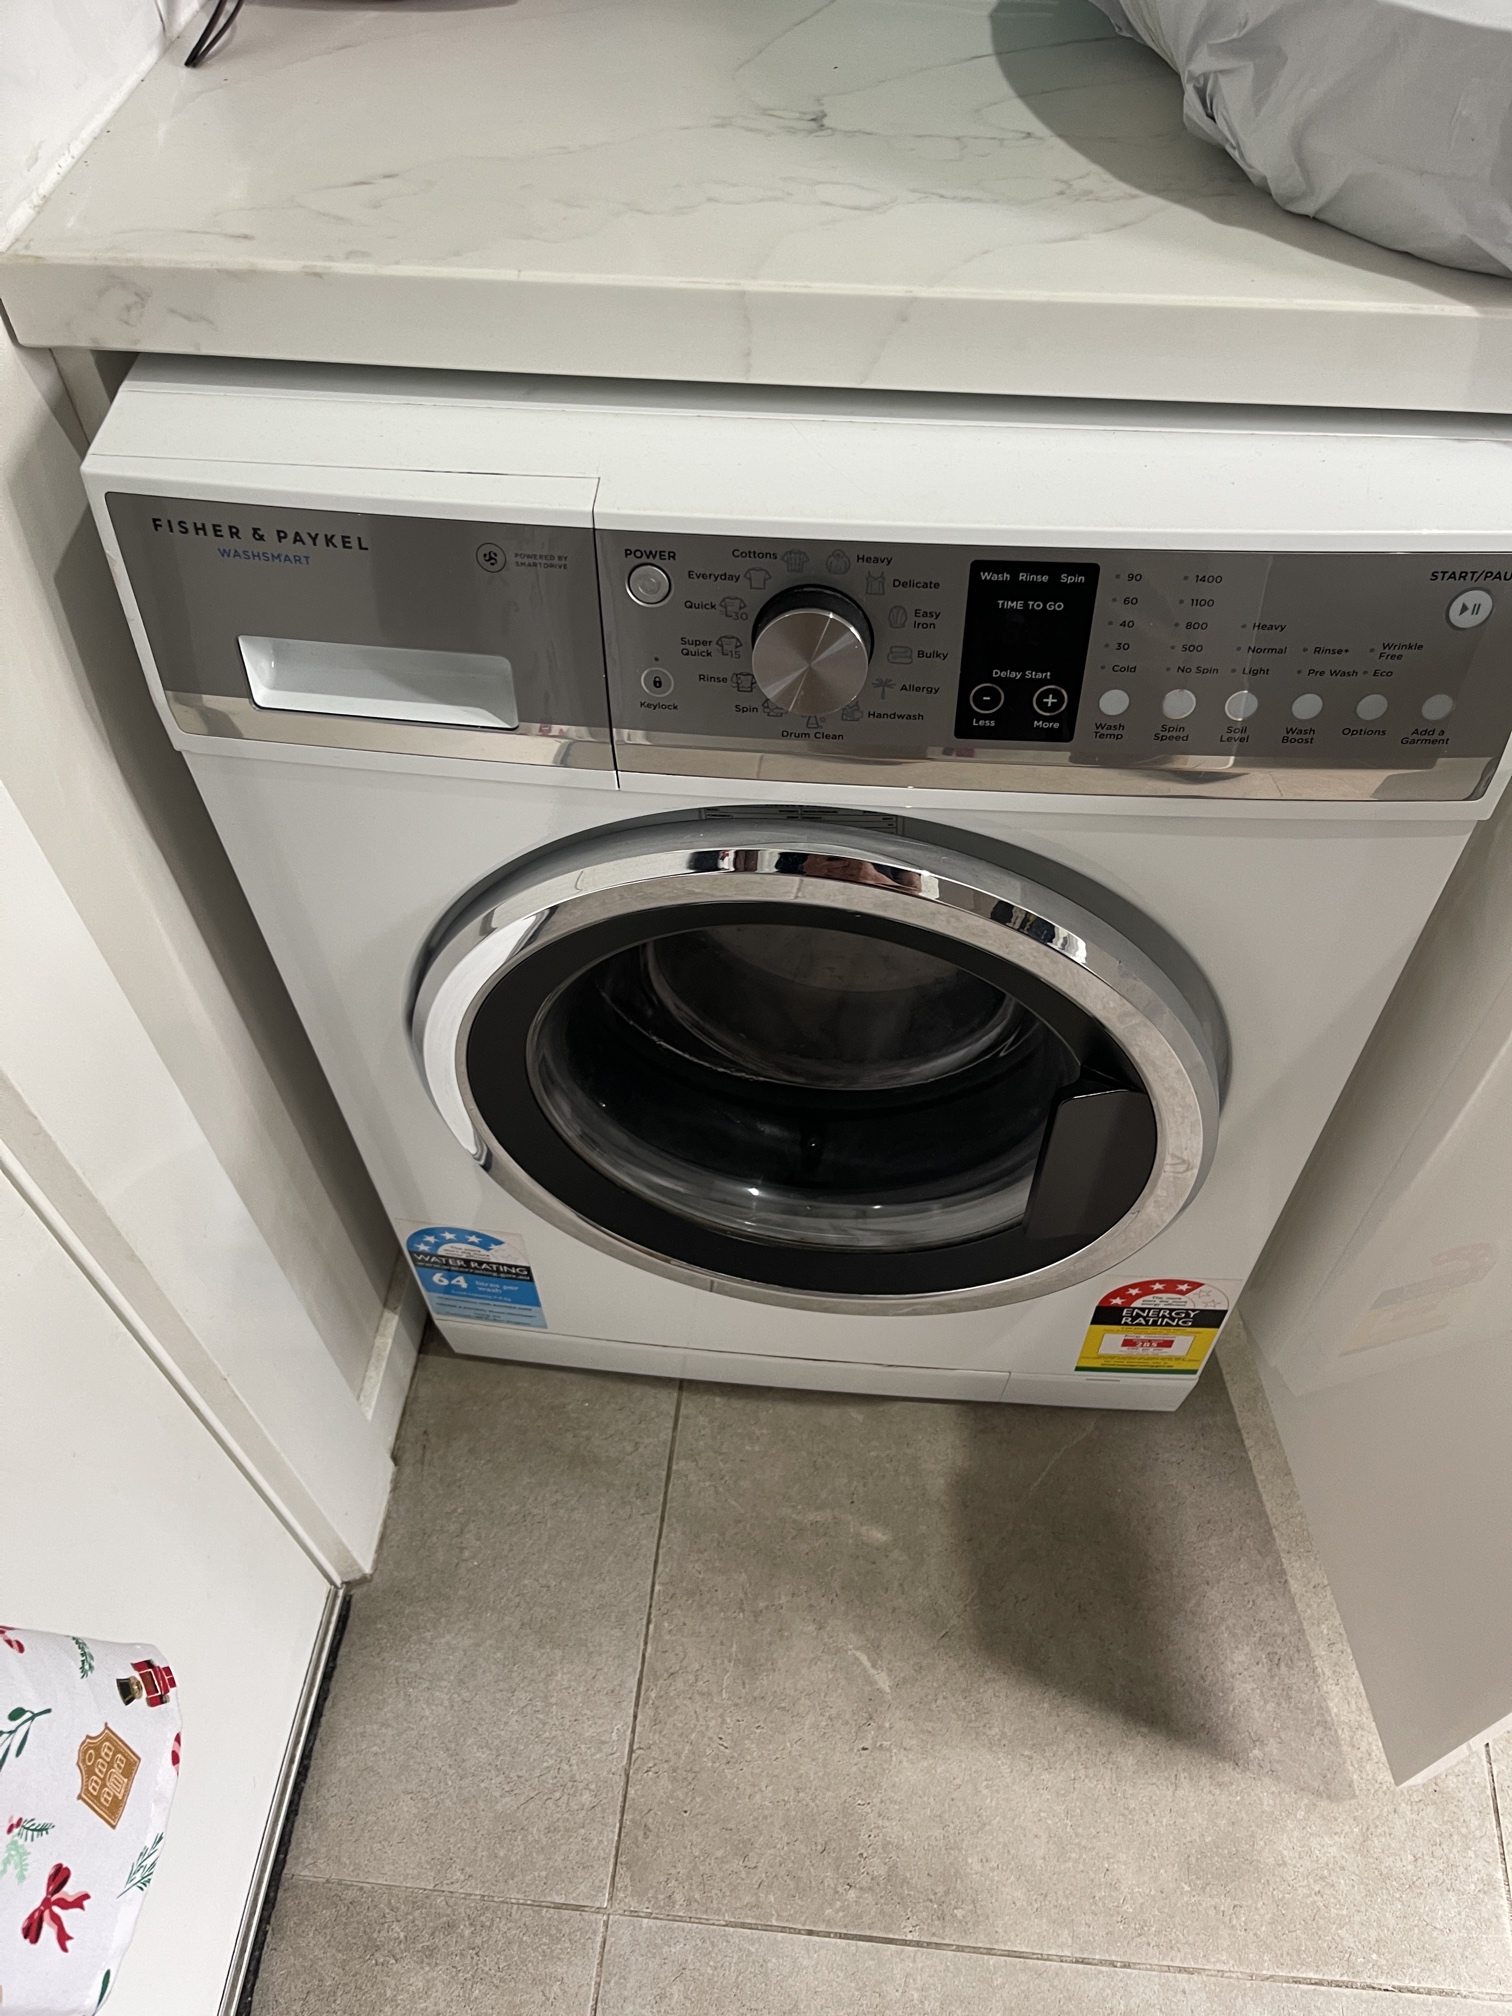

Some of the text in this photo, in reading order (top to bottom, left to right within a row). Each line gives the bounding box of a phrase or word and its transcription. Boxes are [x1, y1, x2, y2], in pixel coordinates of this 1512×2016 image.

[151, 517, 370, 551] FISHER & PAYKEL
[217, 547, 311, 566] WASHSMART
[514, 552, 556, 561] POWERED
[624, 548, 677, 561] POWER
[731, 548, 778, 560] Cottons
[856, 554, 893, 566] Heavy
[514, 561, 568, 570] SMARTDRIVE
[687, 570, 741, 584] Everyday
[980, 571, 1011, 581] Wash
[1018, 572, 1049, 582] Rinse
[1060, 573, 1086, 584] Spin
[1127, 573, 1143, 582] 90
[1194, 574, 1223, 584] 1400
[892, 579, 941, 590] Delicate
[684, 600, 717, 611] Quick
[997, 600, 1064, 611] TIME TO GO
[1123, 597, 1139, 606] 60
[1190, 598, 1215, 607] 1100
[732, 612, 748, 621] 30
[914, 609, 942, 620] Easy
[913, 621, 936, 629] Iron
[1119, 620, 1135, 629] 40
[1185, 621, 1208, 630] 800
[1252, 622, 1287, 633] Heavy
[680, 637, 713, 648] Super
[1115, 642, 1130, 651] 30
[1381, 642, 1424, 651] Wrinkle
[680, 648, 713, 658] Quick
[1180, 644, 1204, 653] 500
[1246, 646, 1288, 655] Normal
[1313, 646, 1350, 655] Rinse+
[917, 650, 949, 661] Bulky
[1378, 652, 1404, 661] Free
[1111, 664, 1137, 673] Cold
[1176, 665, 1219, 675] No Spin
[1242, 666, 1270, 676] Light
[1307, 669, 1359, 677] Pre Wash
[1372, 669, 1393, 677] Eco
[698, 674, 728, 684] Rinse
[992, 669, 1051, 680] Delay Start
[899, 684, 941, 695] Allergy
[639, 701, 679, 711] Keylock
[734, 704, 759, 714] Spin
[867, 711, 924, 721] Handwash
[972, 718, 996, 727] Less
[1033, 720, 1060, 729] More
[1094, 722, 1125, 732] Wash
[1160, 724, 1186, 734] Spin
[1225, 726, 1248, 735] Soil
[1285, 727, 1316, 736] Wash
[1341, 727, 1387, 737] Options
[1410, 728, 1445, 737] Add a
[781, 730, 844, 740] Drum Clean
[1093, 731, 1123, 741] Temp
[1153, 733, 1189, 742] Speed
[1219, 735, 1250, 744] Level
[1281, 736, 1315, 744] Boost
[1400, 737, 1450, 745] Garment
[412, 1253, 465, 1267] WATER
[470, 1261, 529, 1275] RATING
[432, 1272, 469, 1289] 64
[1122, 1308, 1200, 1318] ENERGY
[1121, 1316, 1193, 1326] RATING
